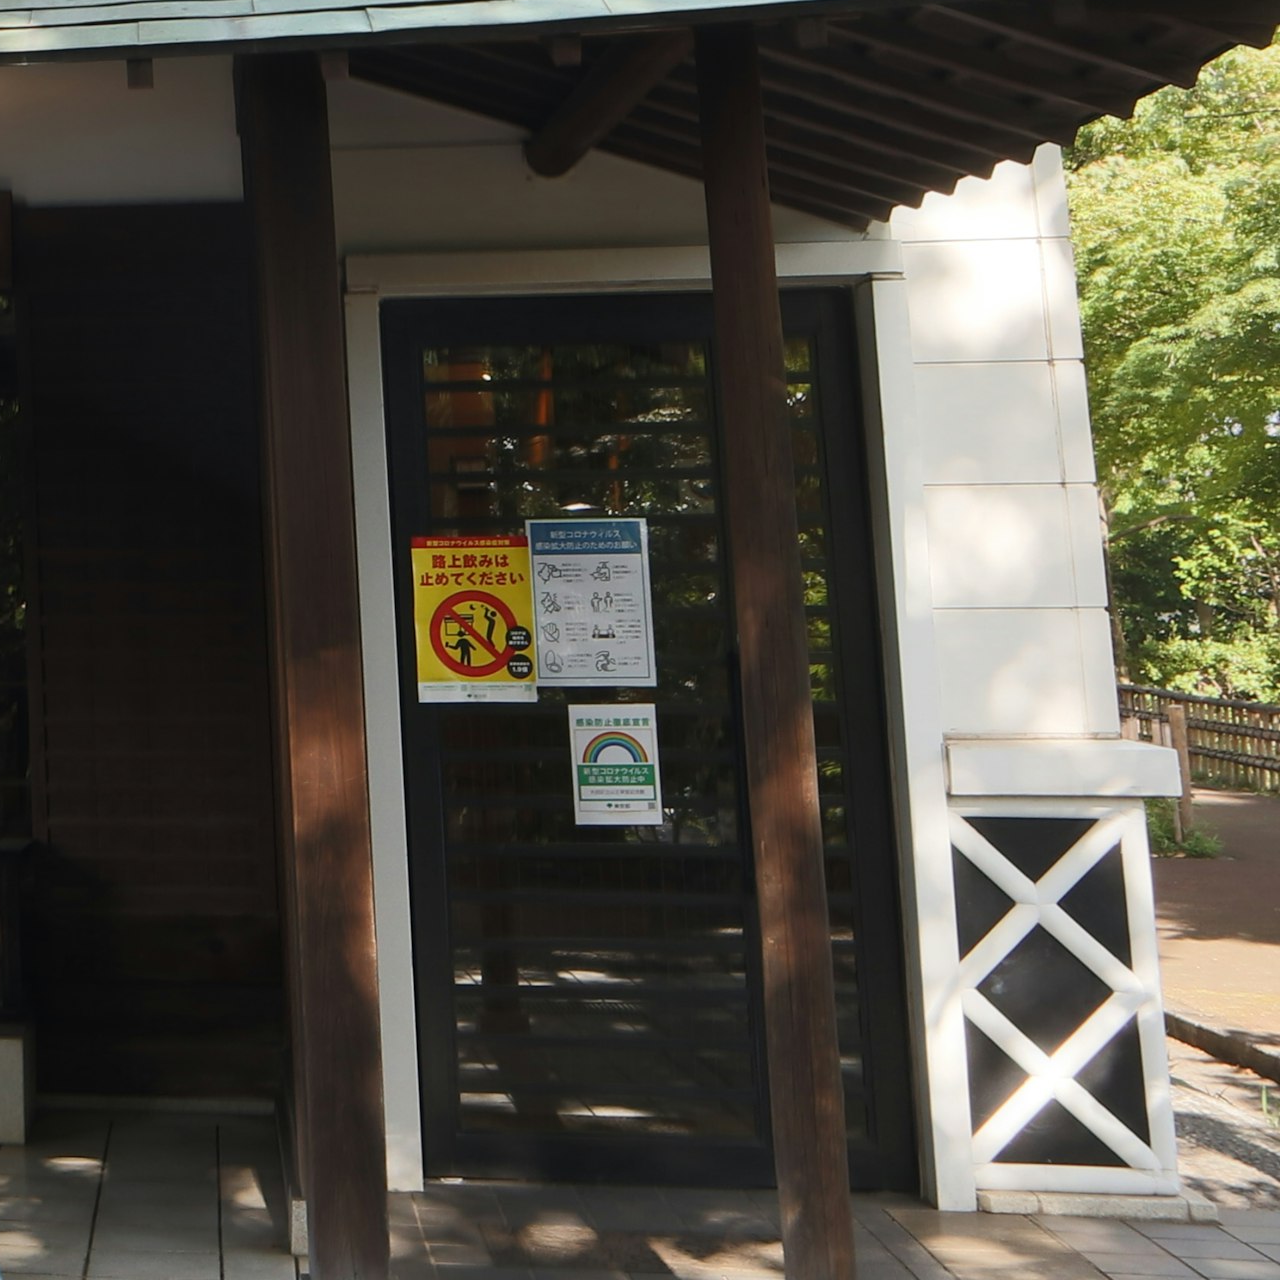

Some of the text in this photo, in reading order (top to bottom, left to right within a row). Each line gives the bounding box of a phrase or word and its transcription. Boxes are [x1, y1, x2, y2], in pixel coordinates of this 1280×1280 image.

[432, 554, 509, 569] 路上飲みは
[420, 571, 524, 586] 止めてください
[576, 717, 650, 727] 感染防止徹底宣言
[583, 767, 649, 775] 新型コロナウイルス
[588, 775, 646, 784] 感染拡大防止中
